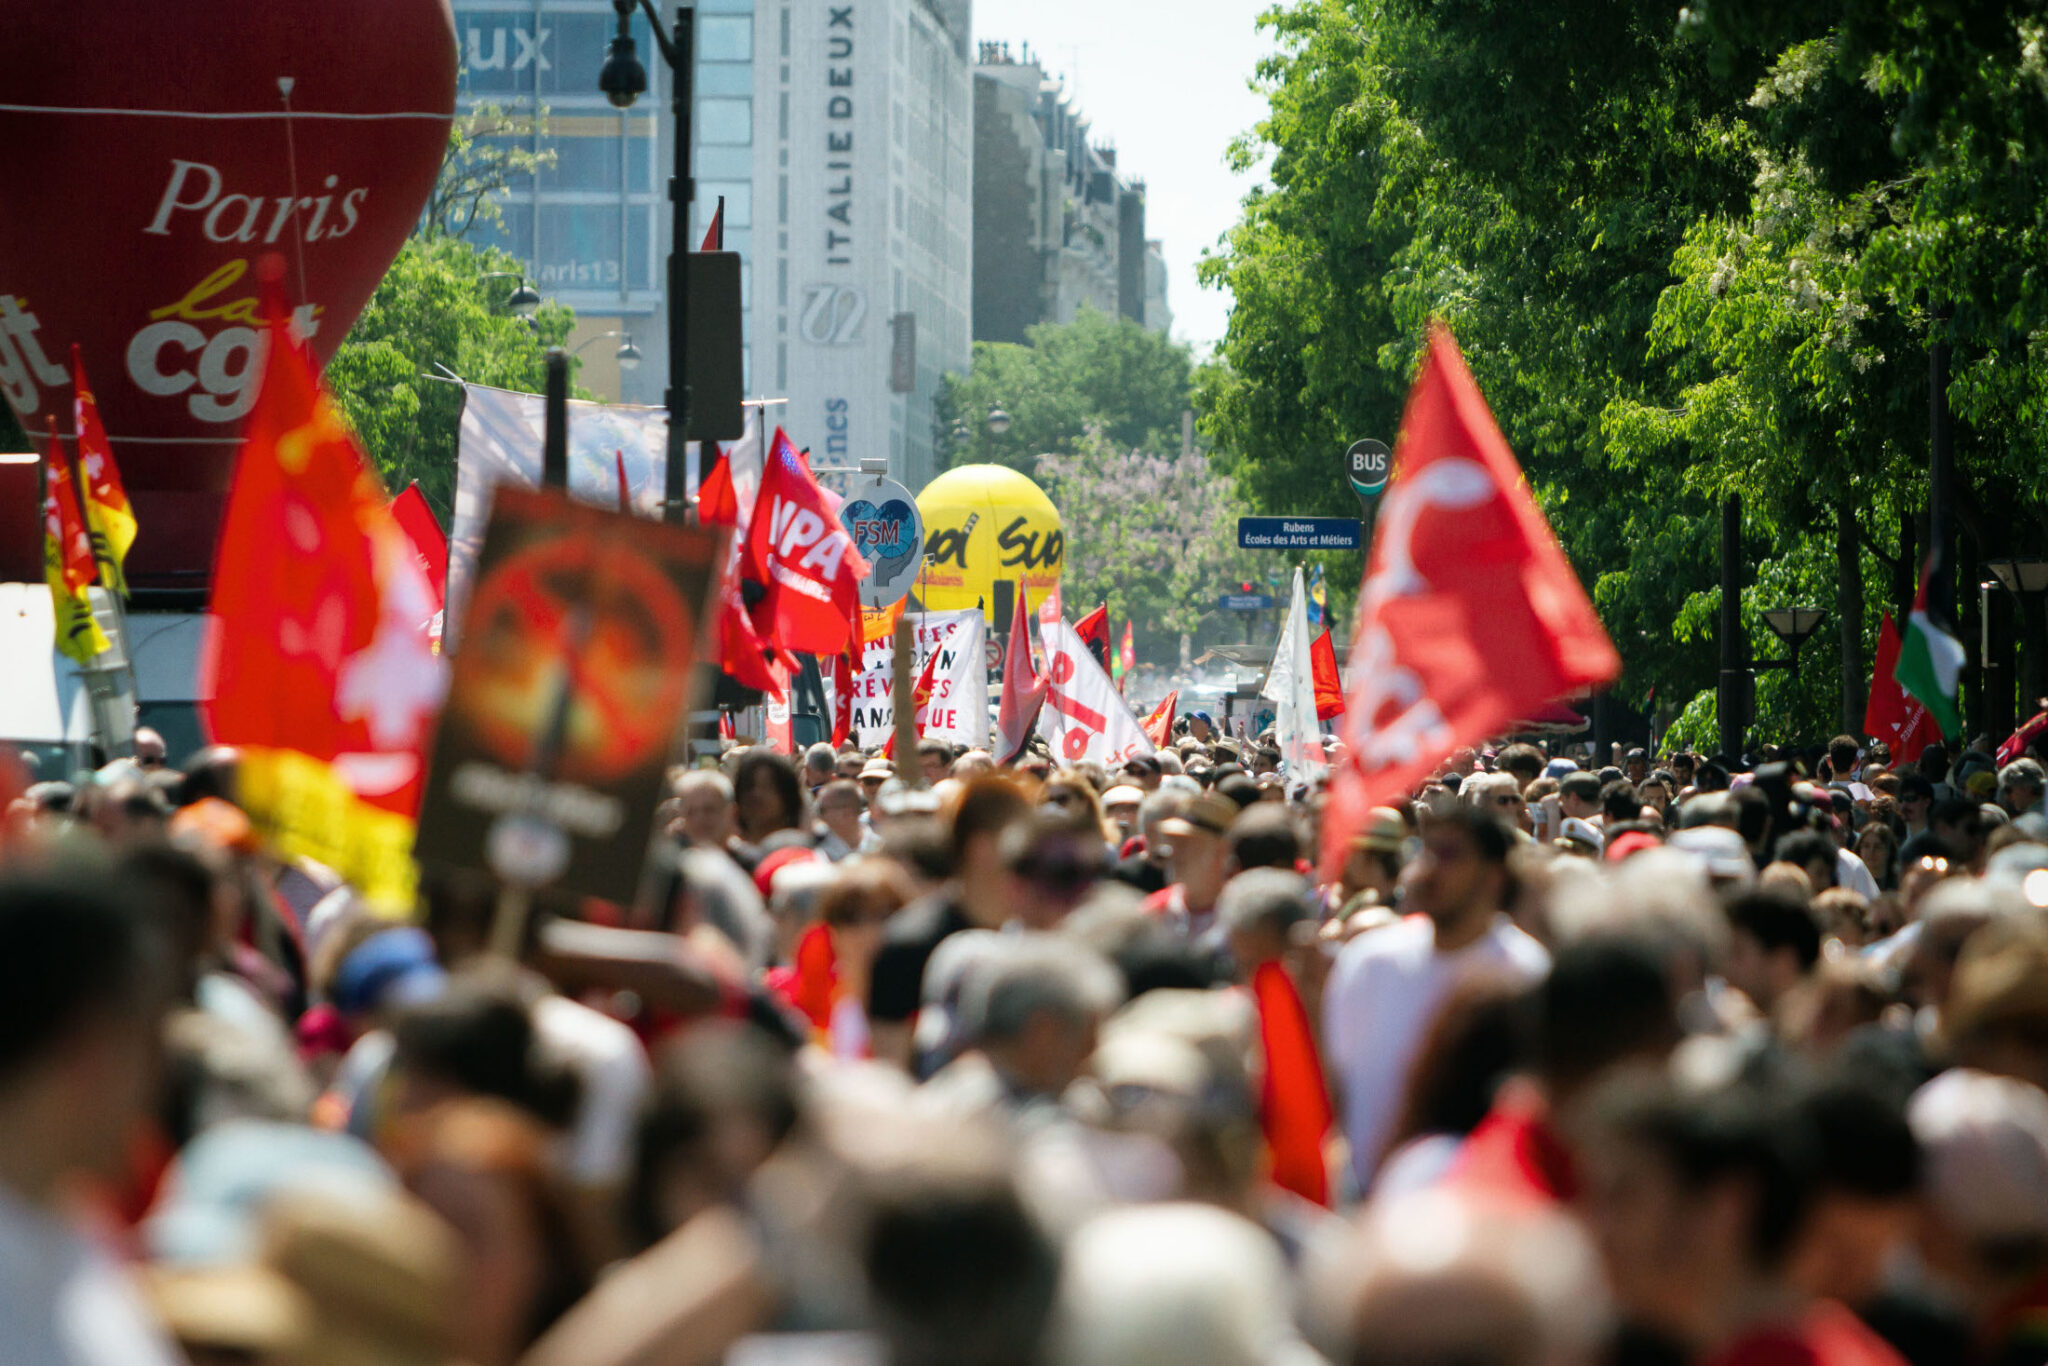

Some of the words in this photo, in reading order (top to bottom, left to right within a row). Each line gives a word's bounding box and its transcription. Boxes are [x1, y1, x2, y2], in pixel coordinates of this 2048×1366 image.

[467, 28, 552, 71] ux
[828, 6, 853, 119] DEUX
[143, 158, 369, 243] Paris
[827, 131, 852, 266] ITALIE
[150, 258, 324, 326] la
[1353, 453, 1386, 471] BUS
[769, 494, 849, 582] NPA
[854, 519, 900, 545] FSM
[1245, 532, 1271, 545] Écoles
[1273, 534, 1288, 545] des
[1289, 534, 1308, 545] Arts
[1309, 535, 1318, 545] et
[1320, 534, 1353, 545] Métiers
[1283, 522, 1315, 533] Rubens
